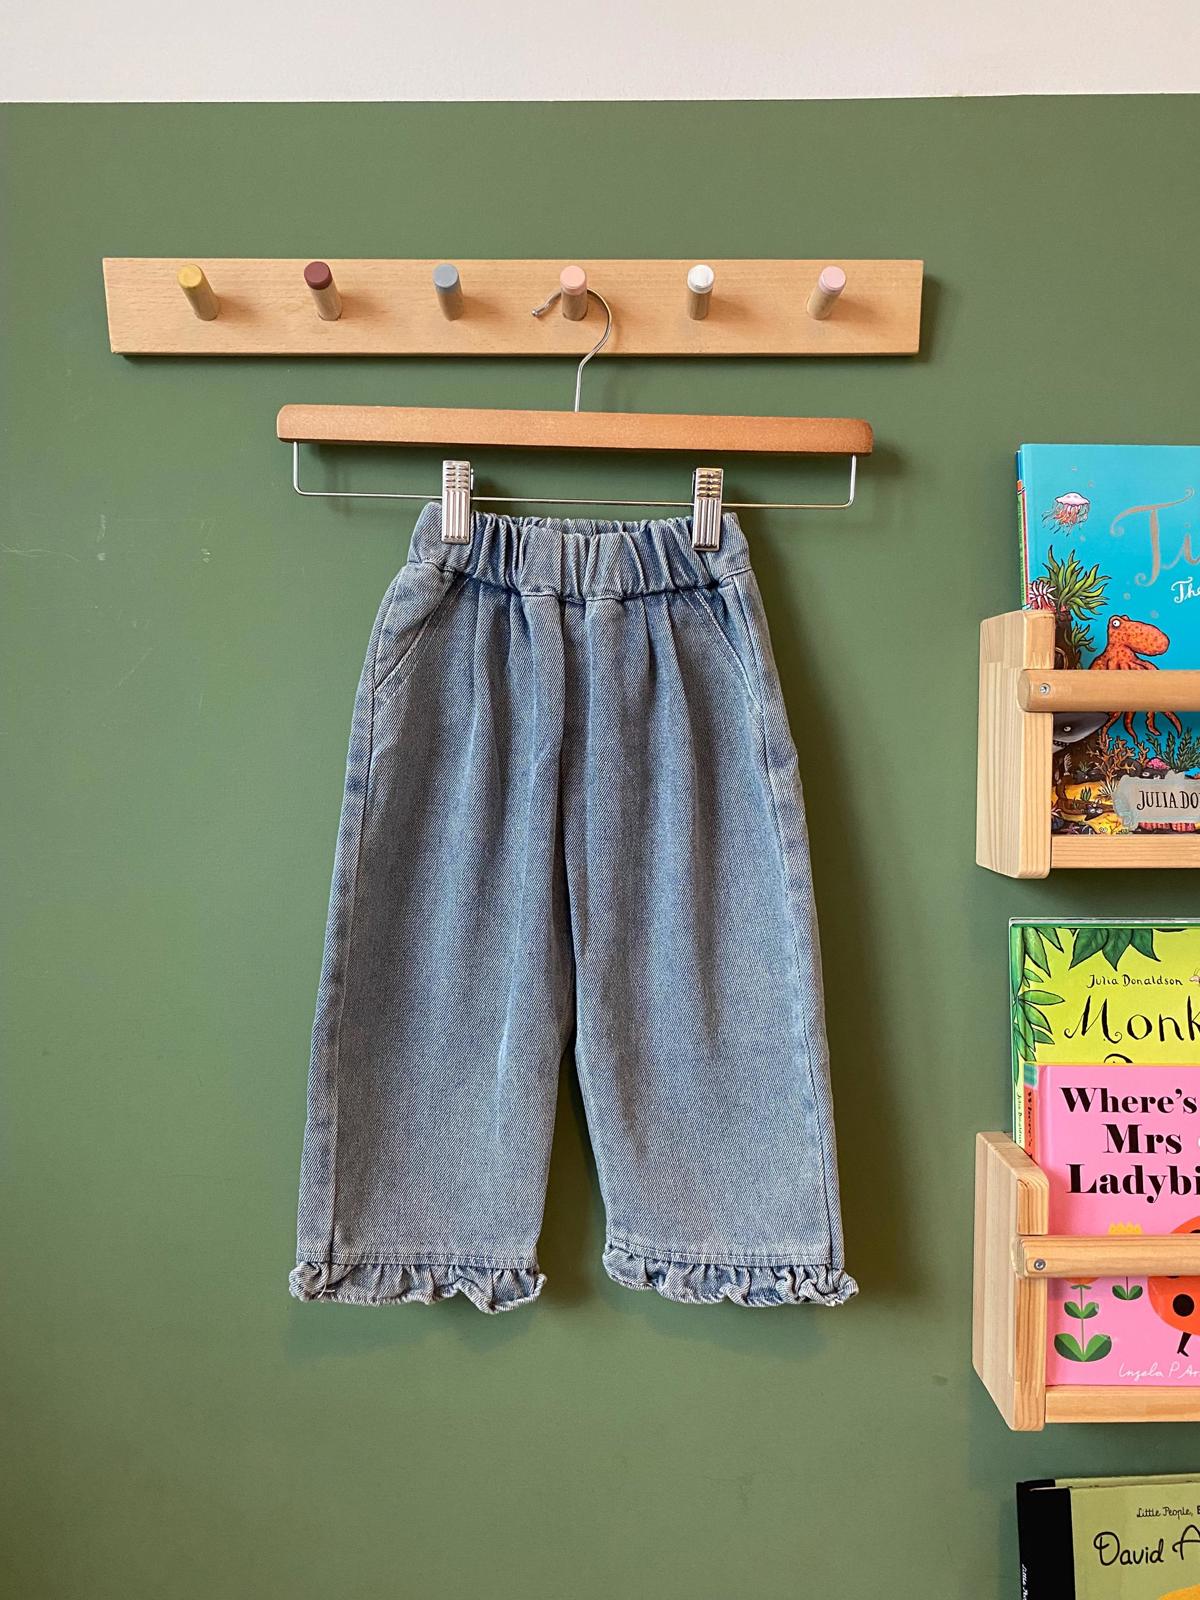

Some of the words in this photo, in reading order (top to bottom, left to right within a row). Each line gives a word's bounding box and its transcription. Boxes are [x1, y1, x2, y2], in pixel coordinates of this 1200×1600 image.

[1136, 790, 1179, 810] JULIA
[1179, 790, 1200, 810] DO
[1087, 974, 1119, 989] Julia
[1122, 974, 1184, 987] Donaldson
[1063, 994, 1200, 1044] Monk
[1059, 1087, 1198, 1114] Where's
[1103, 1123, 1183, 1155] Mrs
[1136, 1507, 1161, 1517] Little
[1162, 1506, 1193, 1520] People,
[1093, 1531, 1164, 1566] David
